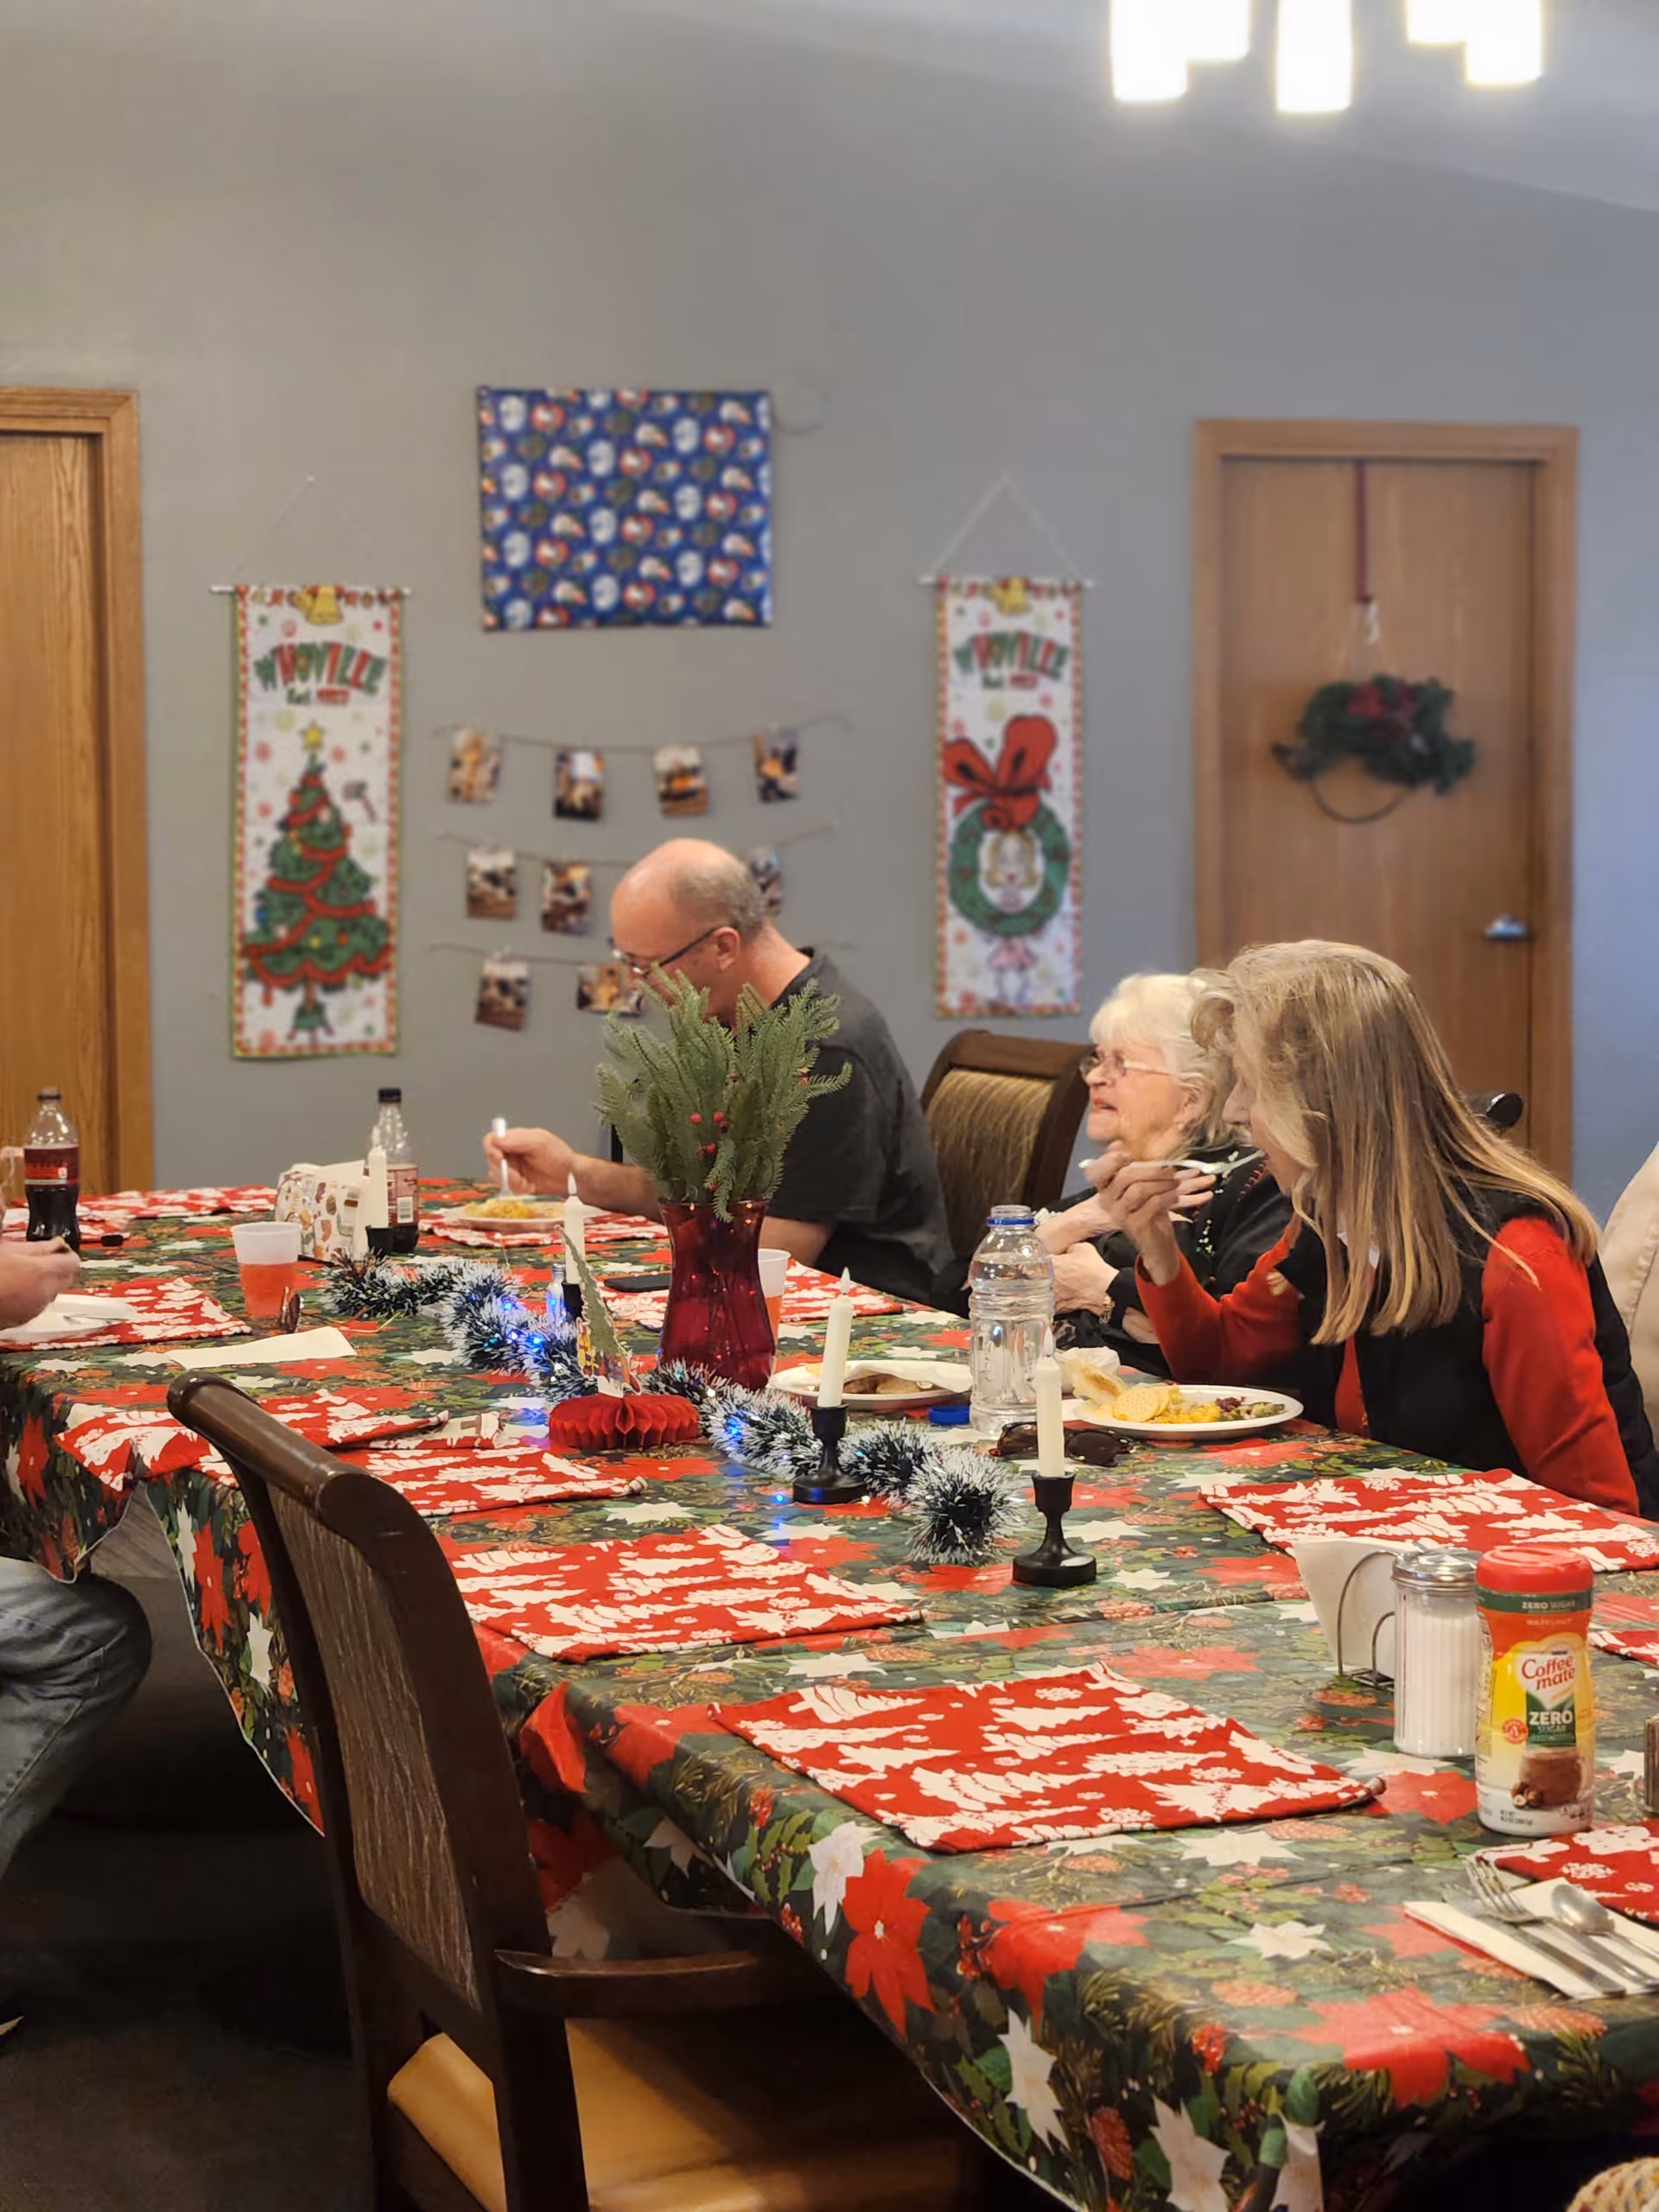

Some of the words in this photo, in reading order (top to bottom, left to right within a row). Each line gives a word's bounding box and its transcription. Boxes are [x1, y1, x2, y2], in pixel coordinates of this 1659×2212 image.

[1522, 1601, 1548, 1610] ZERO
[1550, 1599, 1576, 1609] SUGAR
[1522, 1656, 1574, 1680] Coffee
[1536, 1667, 1576, 1690] mate
[1529, 1710, 1573, 1726] ZERO
[1537, 1725, 1567, 1734] SUGAR
